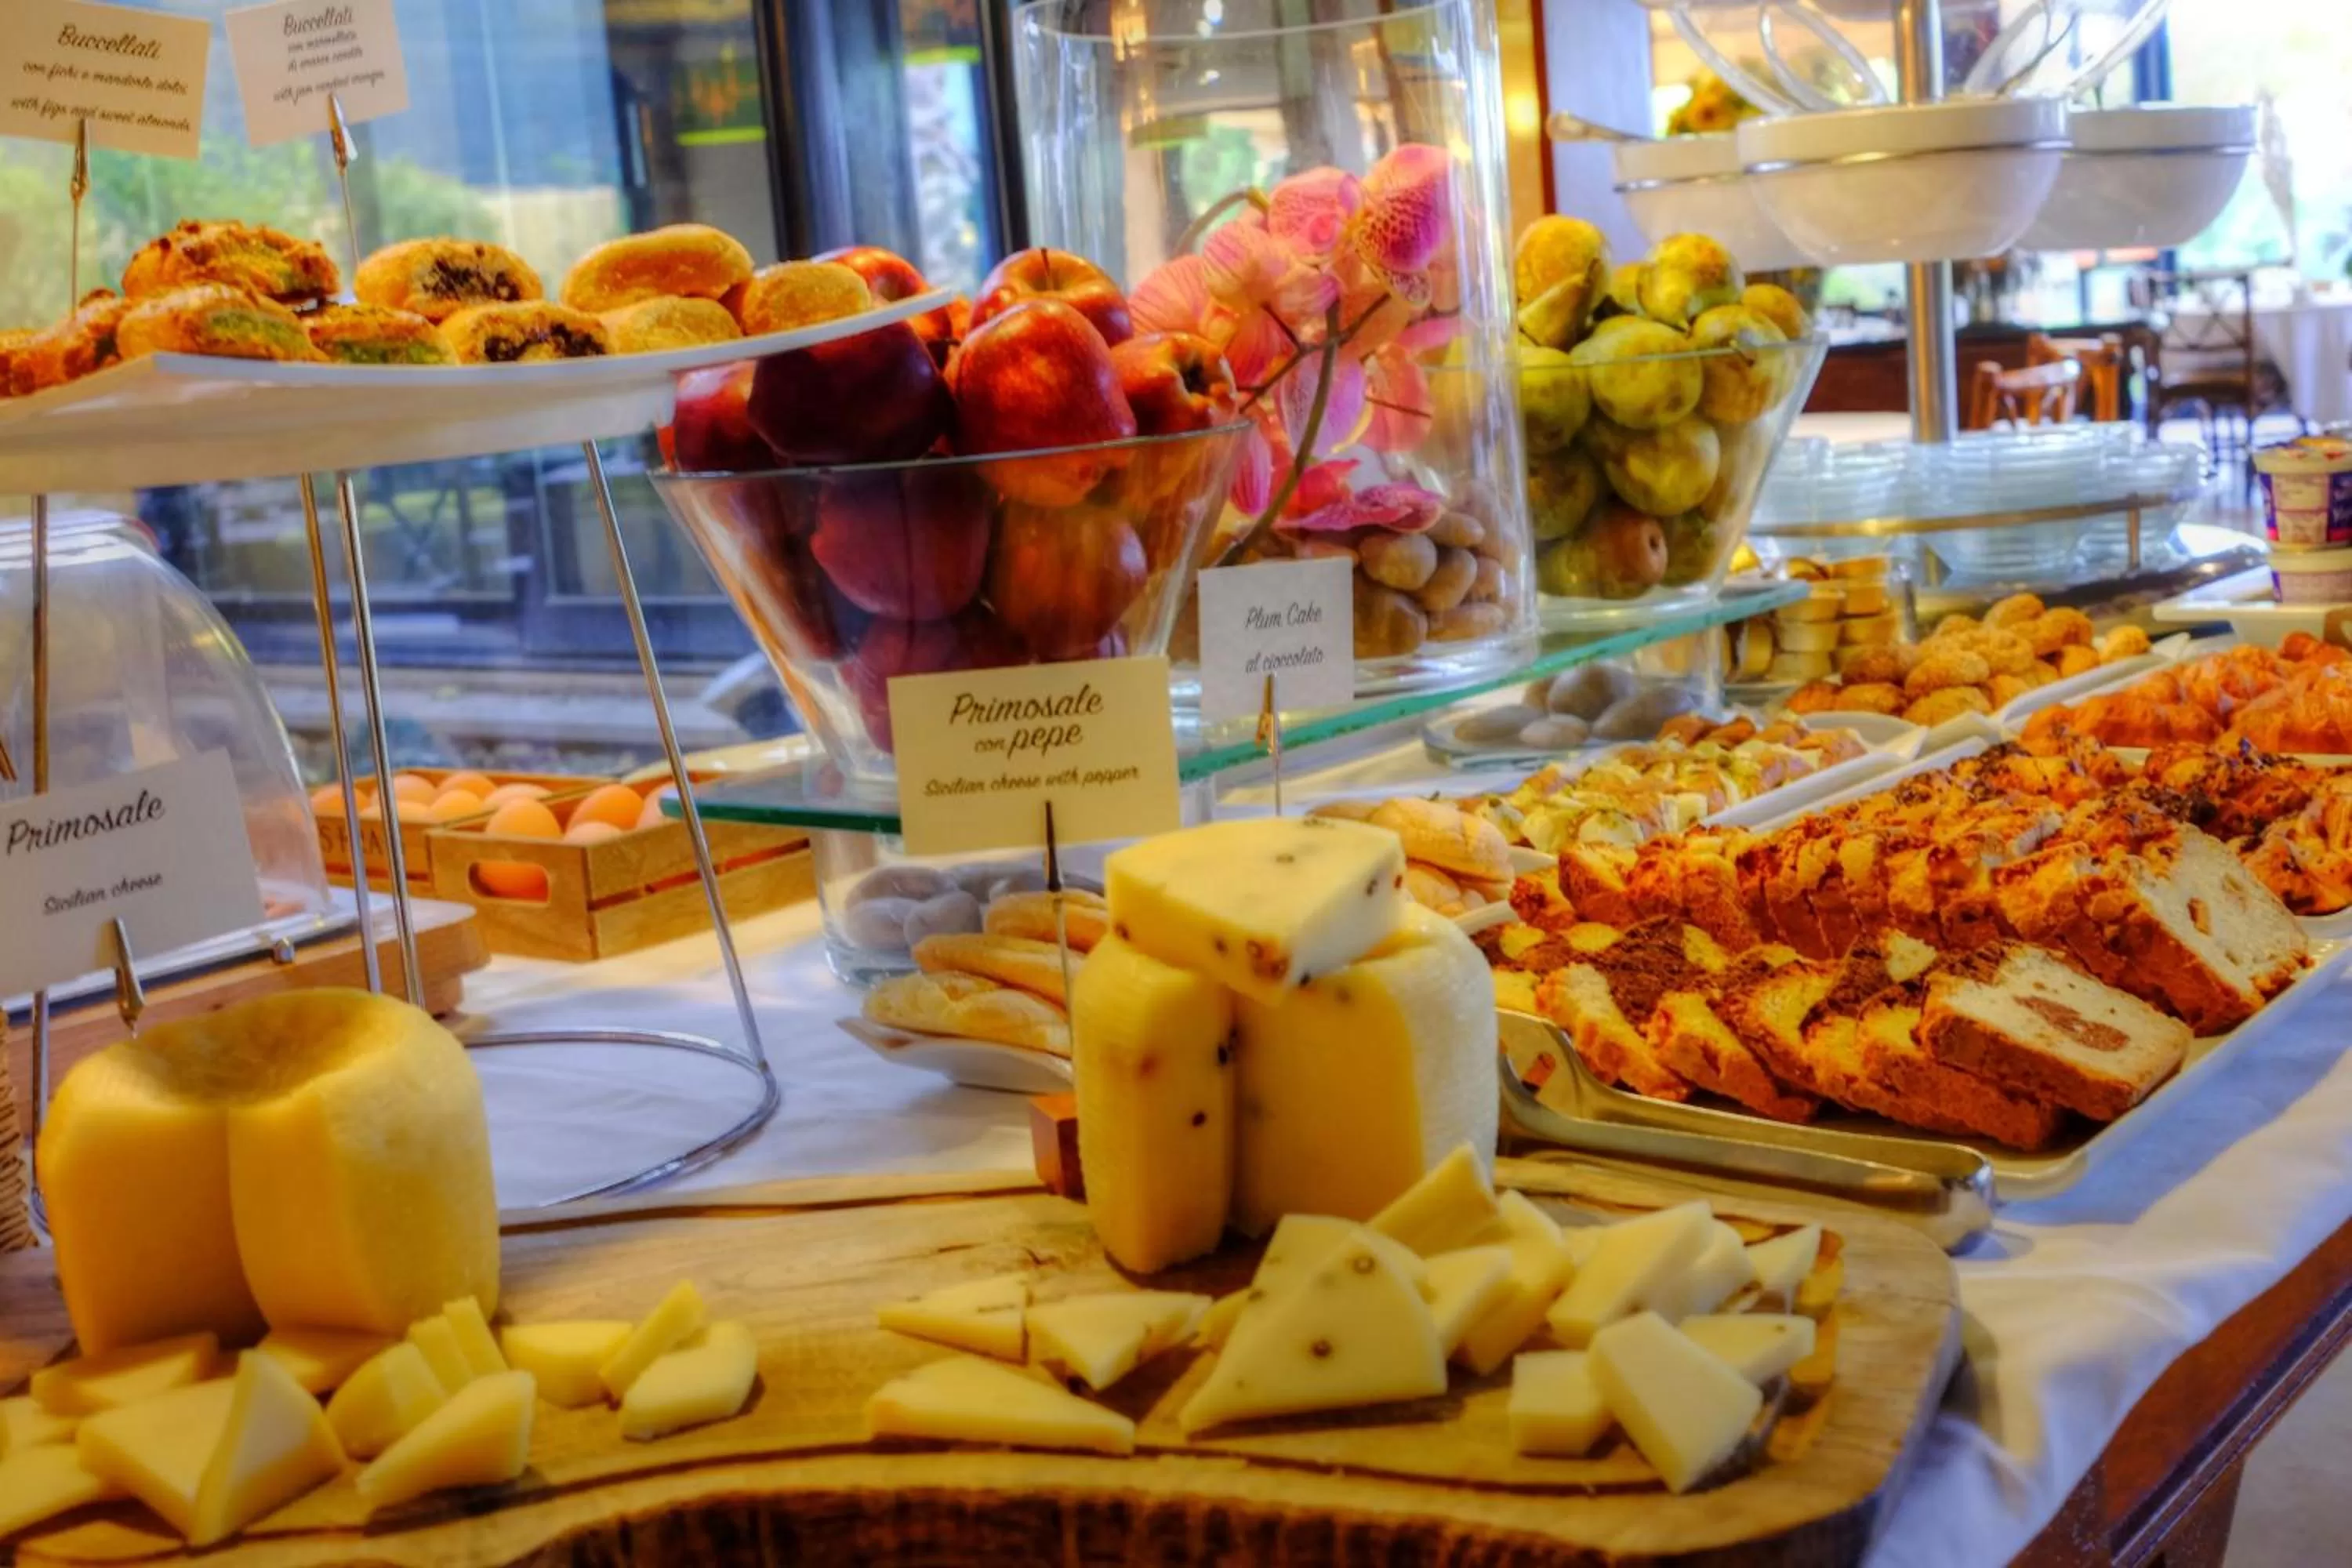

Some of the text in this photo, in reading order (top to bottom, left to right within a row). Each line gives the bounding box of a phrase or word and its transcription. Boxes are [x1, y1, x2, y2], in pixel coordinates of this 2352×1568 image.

[57, 22, 162, 59] Buccellati
[1245, 601, 1323, 630] Plum Cake
[1245, 646, 1324, 674] al cioccolato
[949, 684, 1104, 725] Primosale
[975, 724, 1083, 759] con pepe
[924, 777, 985, 797] Sicilian
[991, 772, 1041, 791] cheese
[1045, 767, 1079, 786] with
[6, 787, 166, 855] Primosale
[43, 872, 164, 916] Sicilian cheese
